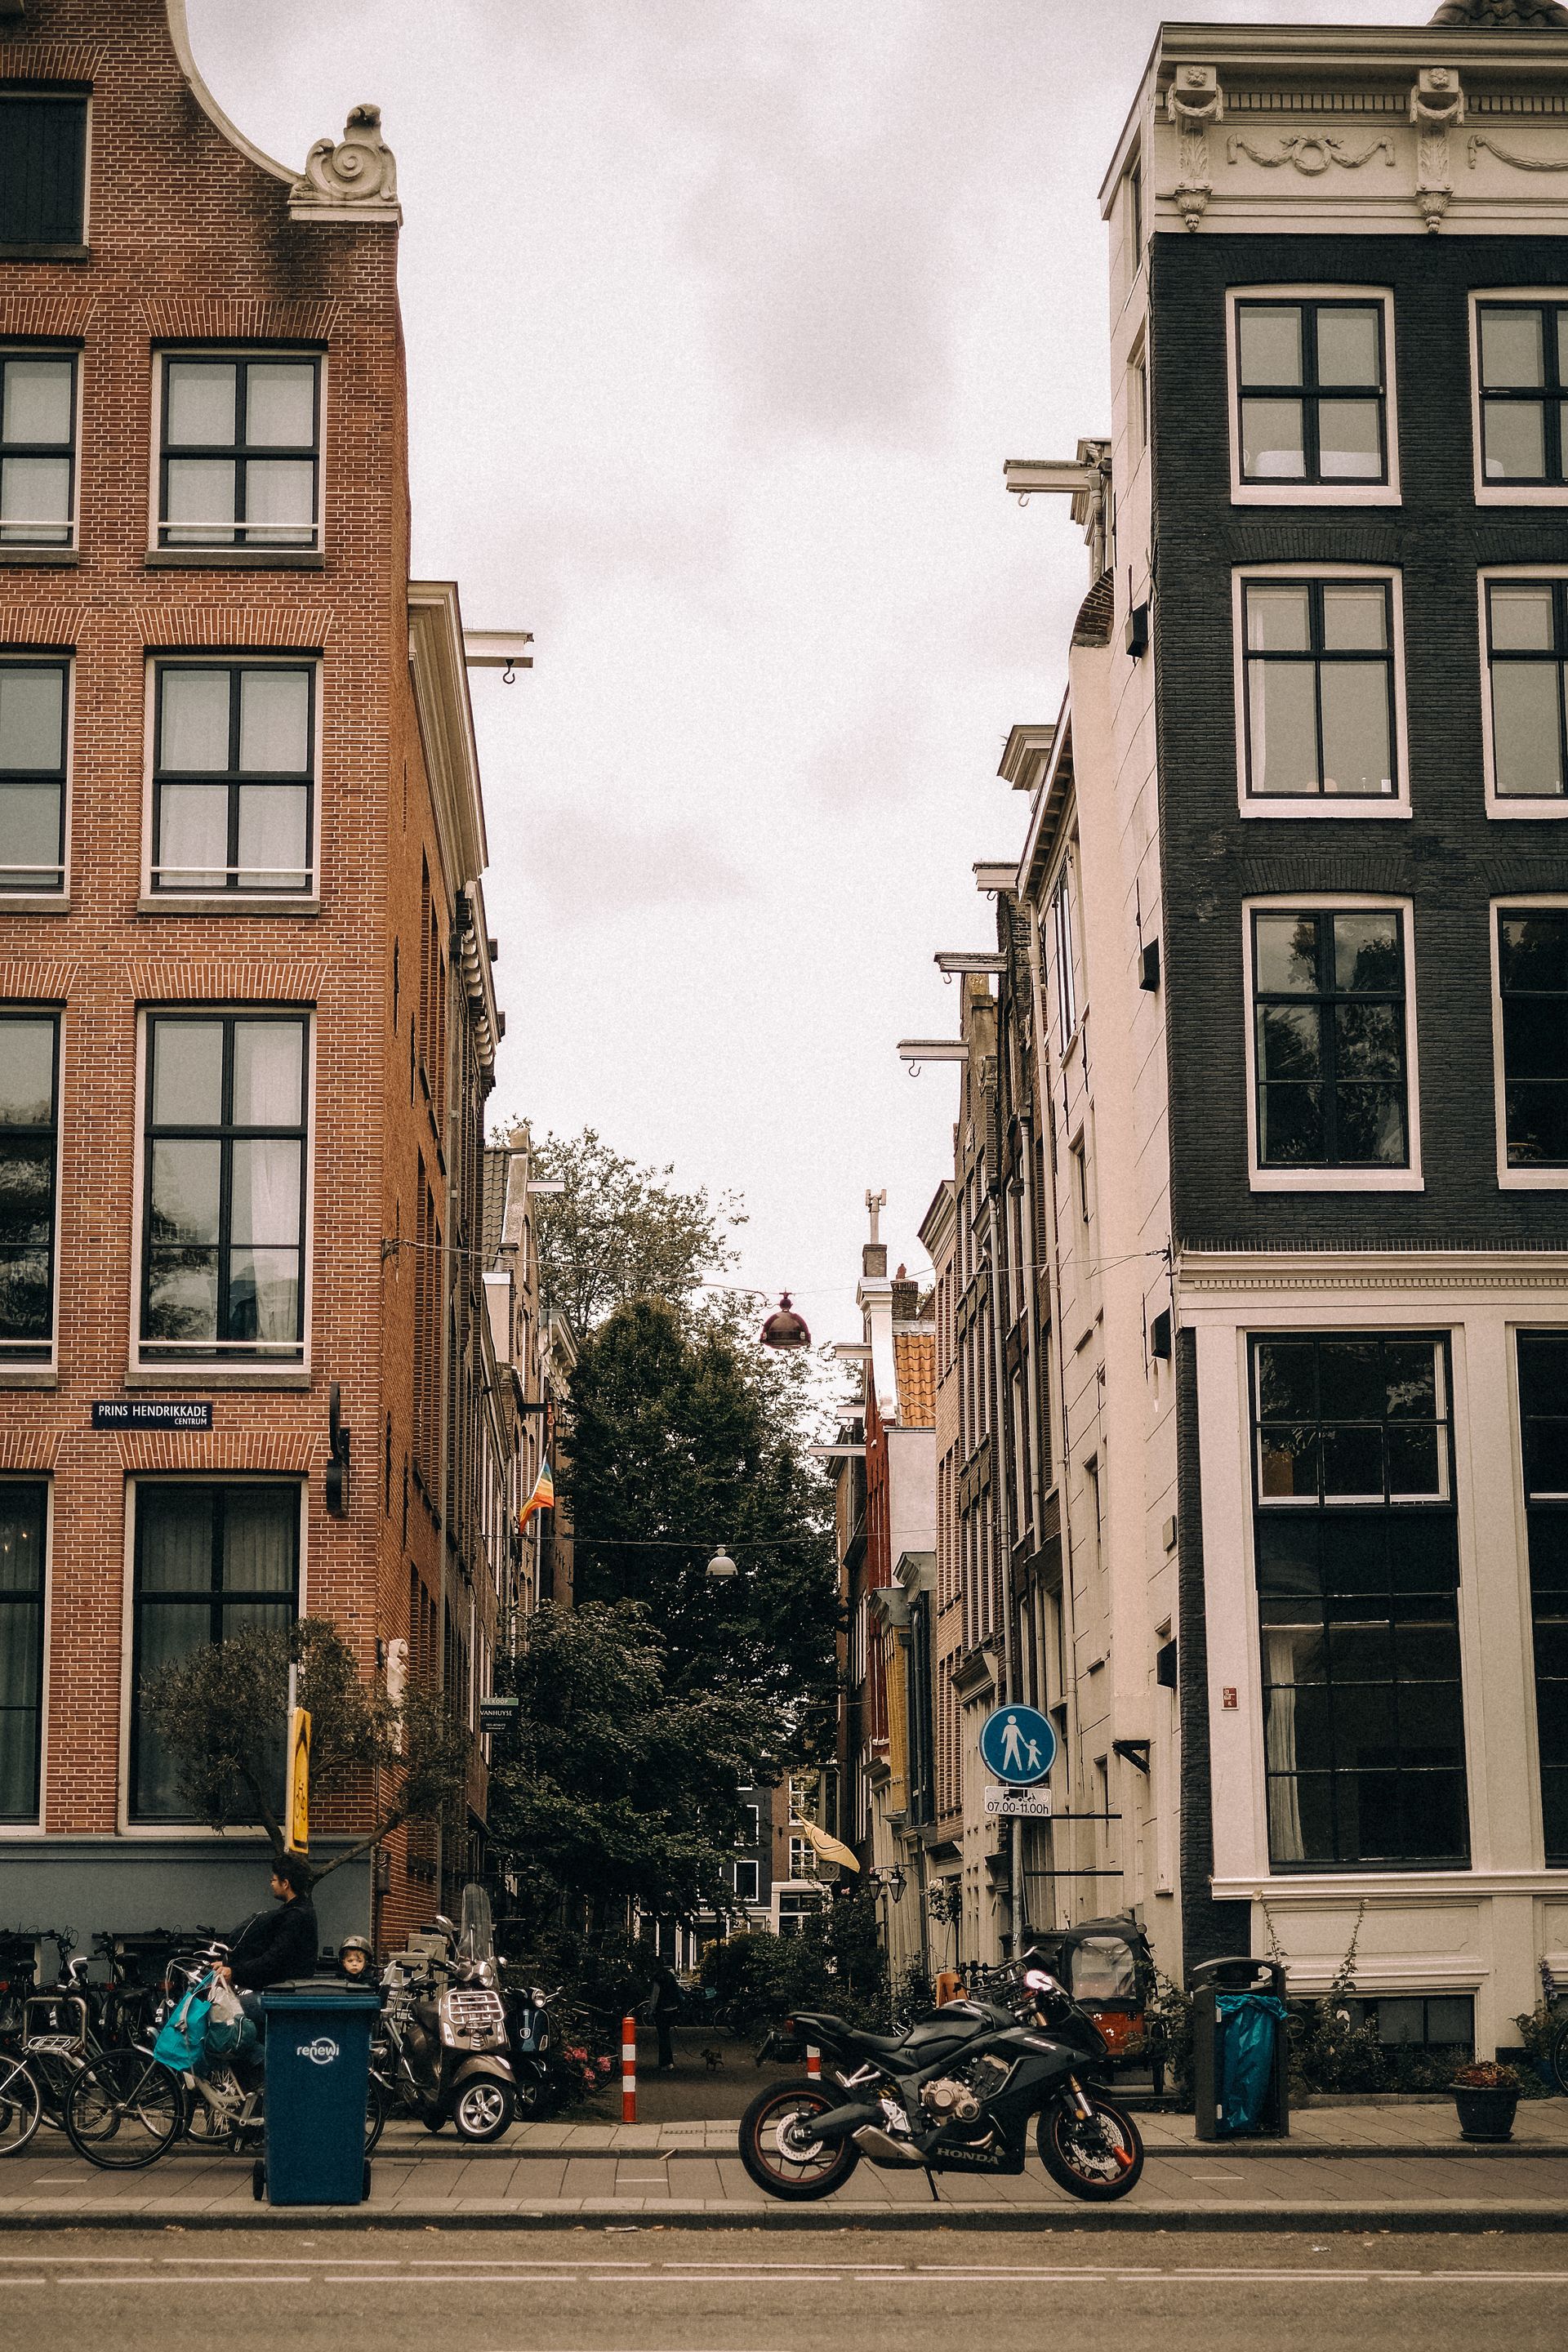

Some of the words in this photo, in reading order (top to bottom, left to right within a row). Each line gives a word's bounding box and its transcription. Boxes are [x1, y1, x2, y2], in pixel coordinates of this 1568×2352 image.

[98, 1405, 128, 1416] PRINS
[132, 1405, 207, 1417] HENDRIKKADE
[987, 1802, 1049, 1815] 07.00-11.00h
[296, 2043, 340, 2056] renewi
[936, 2146, 1000, 2165] HONDA
